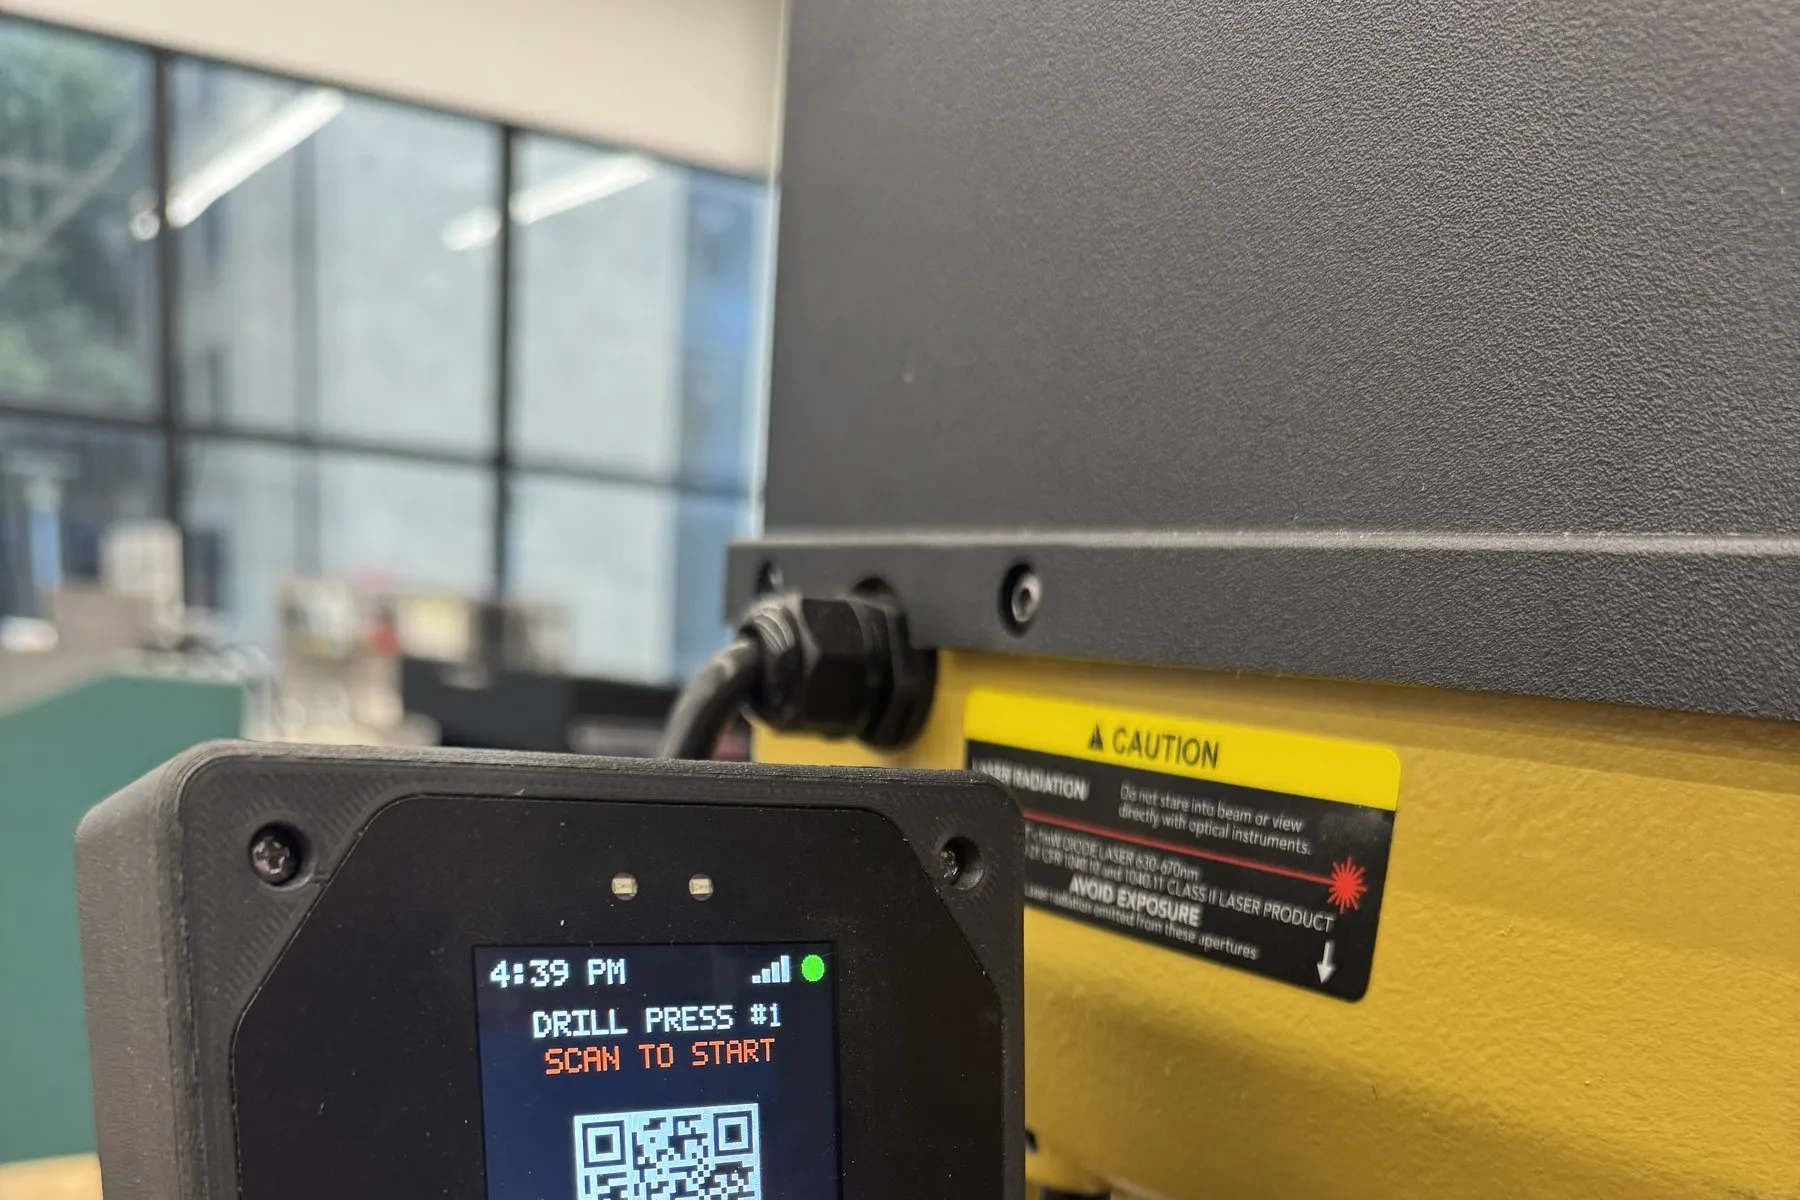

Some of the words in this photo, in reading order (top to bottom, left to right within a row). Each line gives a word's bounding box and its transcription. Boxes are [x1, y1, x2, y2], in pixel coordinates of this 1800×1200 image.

[1112, 727, 1220, 770] CAUTION
[1013, 764, 1090, 801] RADIATION
[1119, 802, 1159, 829] directly
[1161, 812, 1186, 830] with
[1189, 818, 1229, 839] optical
[1232, 825, 1312, 855] instruments.
[1120, 781, 1136, 800] Do
[1139, 790, 1157, 805] not
[1160, 794, 1189, 812] stare
[1191, 799, 1214, 816] into
[1217, 802, 1251, 823] beam
[1255, 813, 1268, 827] or
[1272, 813, 1303, 833] view
[1099, 845, 1134, 867] LASER
[1069, 873, 1117, 905] AVOID
[1117, 886, 1203, 928] EXPOSURE
[1101, 864, 1123, 882] and
[1167, 877, 1208, 902] CLASS
[1208, 887, 1216, 905] II
[1218, 889, 1260, 916] LASER
[1263, 902, 1336, 933] PRODUCT
[1093, 904, 1136, 928] emitted
[1136, 912, 1163, 934] from
[1164, 921, 1197, 945] these
[1198, 932, 1258, 961] apertures
[490, 959, 570, 989] 4:39
[587, 958, 627, 986] PM
[532, 1008, 629, 1039] DRILL
[645, 1004, 735, 1034] PRESS
[750, 1002, 782, 1028] #1
[544, 1045, 621, 1075] SCAN
[638, 1042, 674, 1069] TO
[692, 1037, 776, 1067] START
